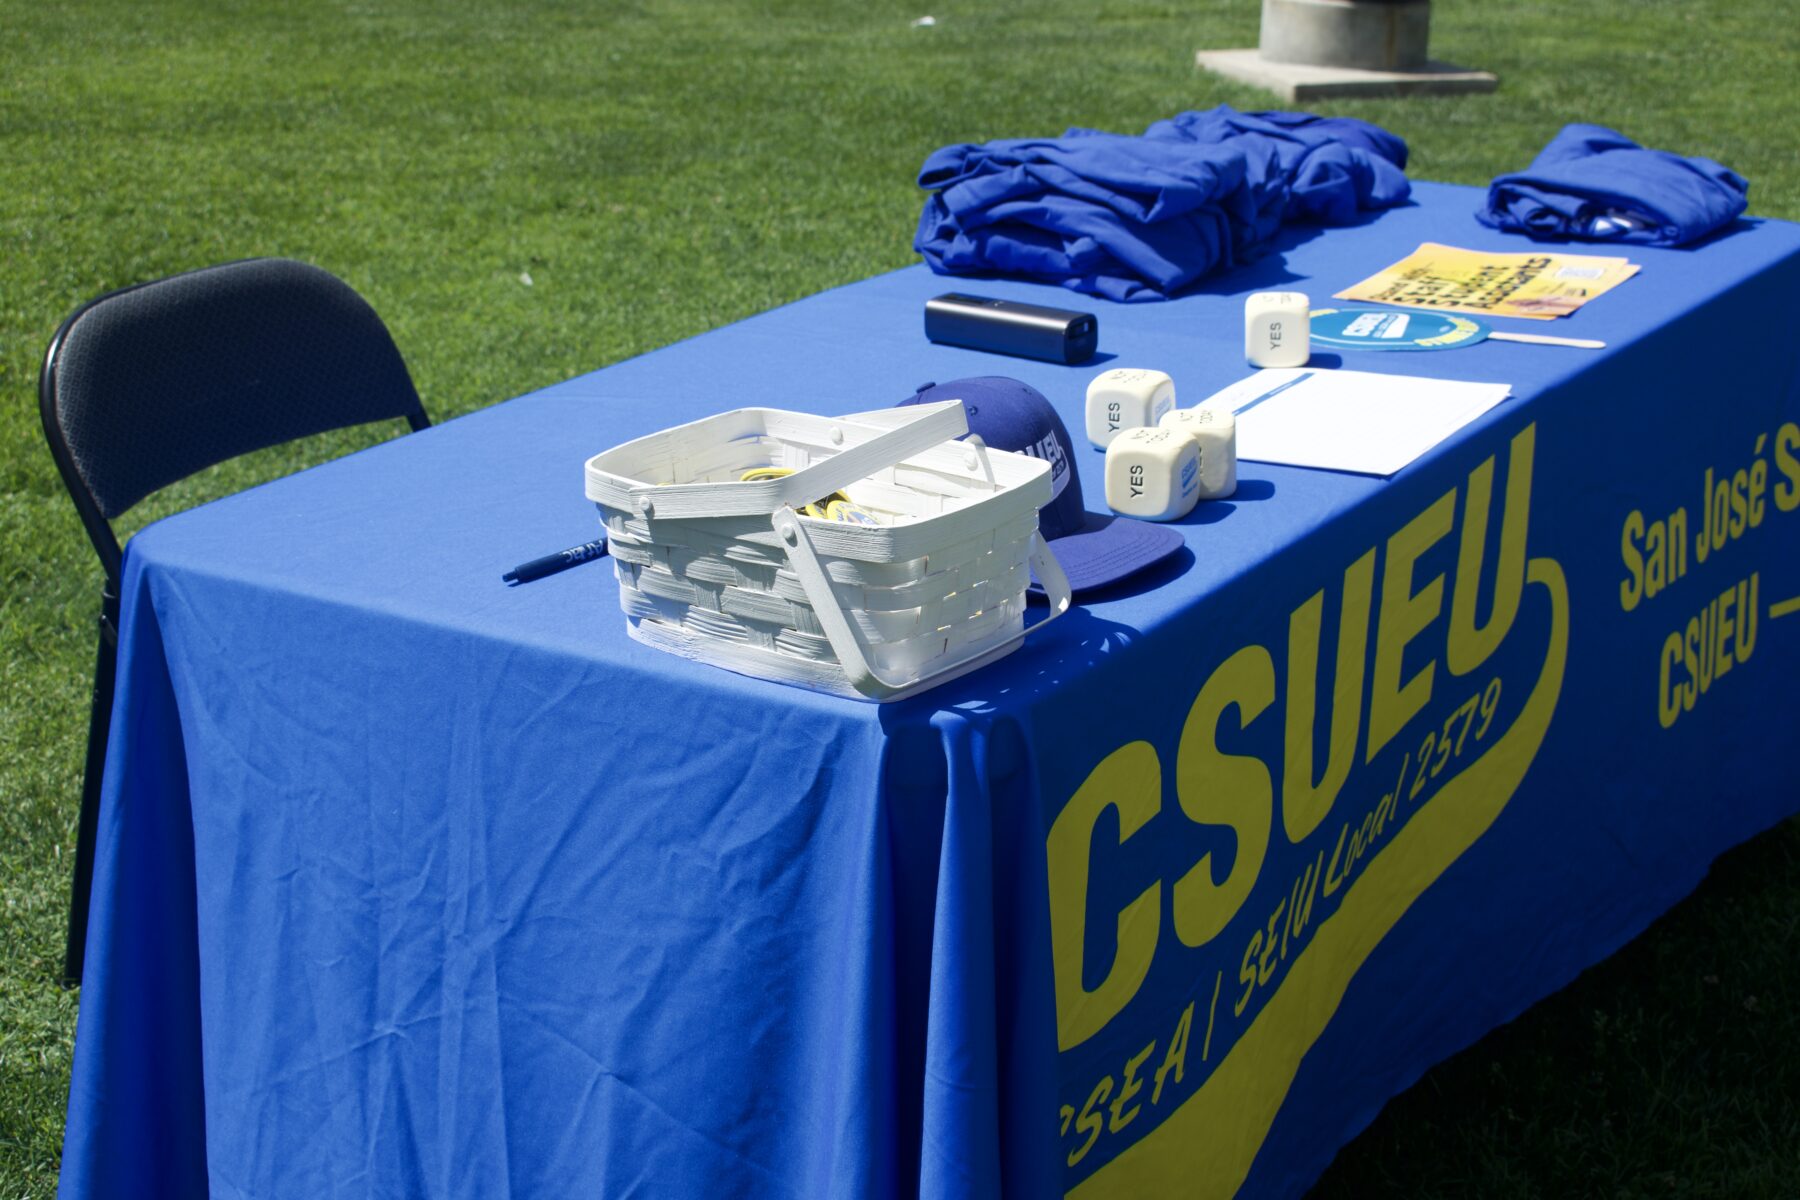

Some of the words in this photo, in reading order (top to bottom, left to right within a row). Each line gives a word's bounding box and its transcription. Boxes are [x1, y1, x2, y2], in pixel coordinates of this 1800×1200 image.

[1269, 322, 1282, 350] YES
[1108, 402, 1121, 433] YES
[1129, 464, 1144, 499] YES
[1620, 509, 1688, 613] San
[1696, 432, 1768, 564] José
[1658, 572, 1760, 729] CSUEU
[1046, 422, 1537, 1053] CSUEU
[1234, 849, 1324, 1018] SEIU
[1323, 752, 1409, 898] Local
[1409, 677, 1502, 801] 2579
